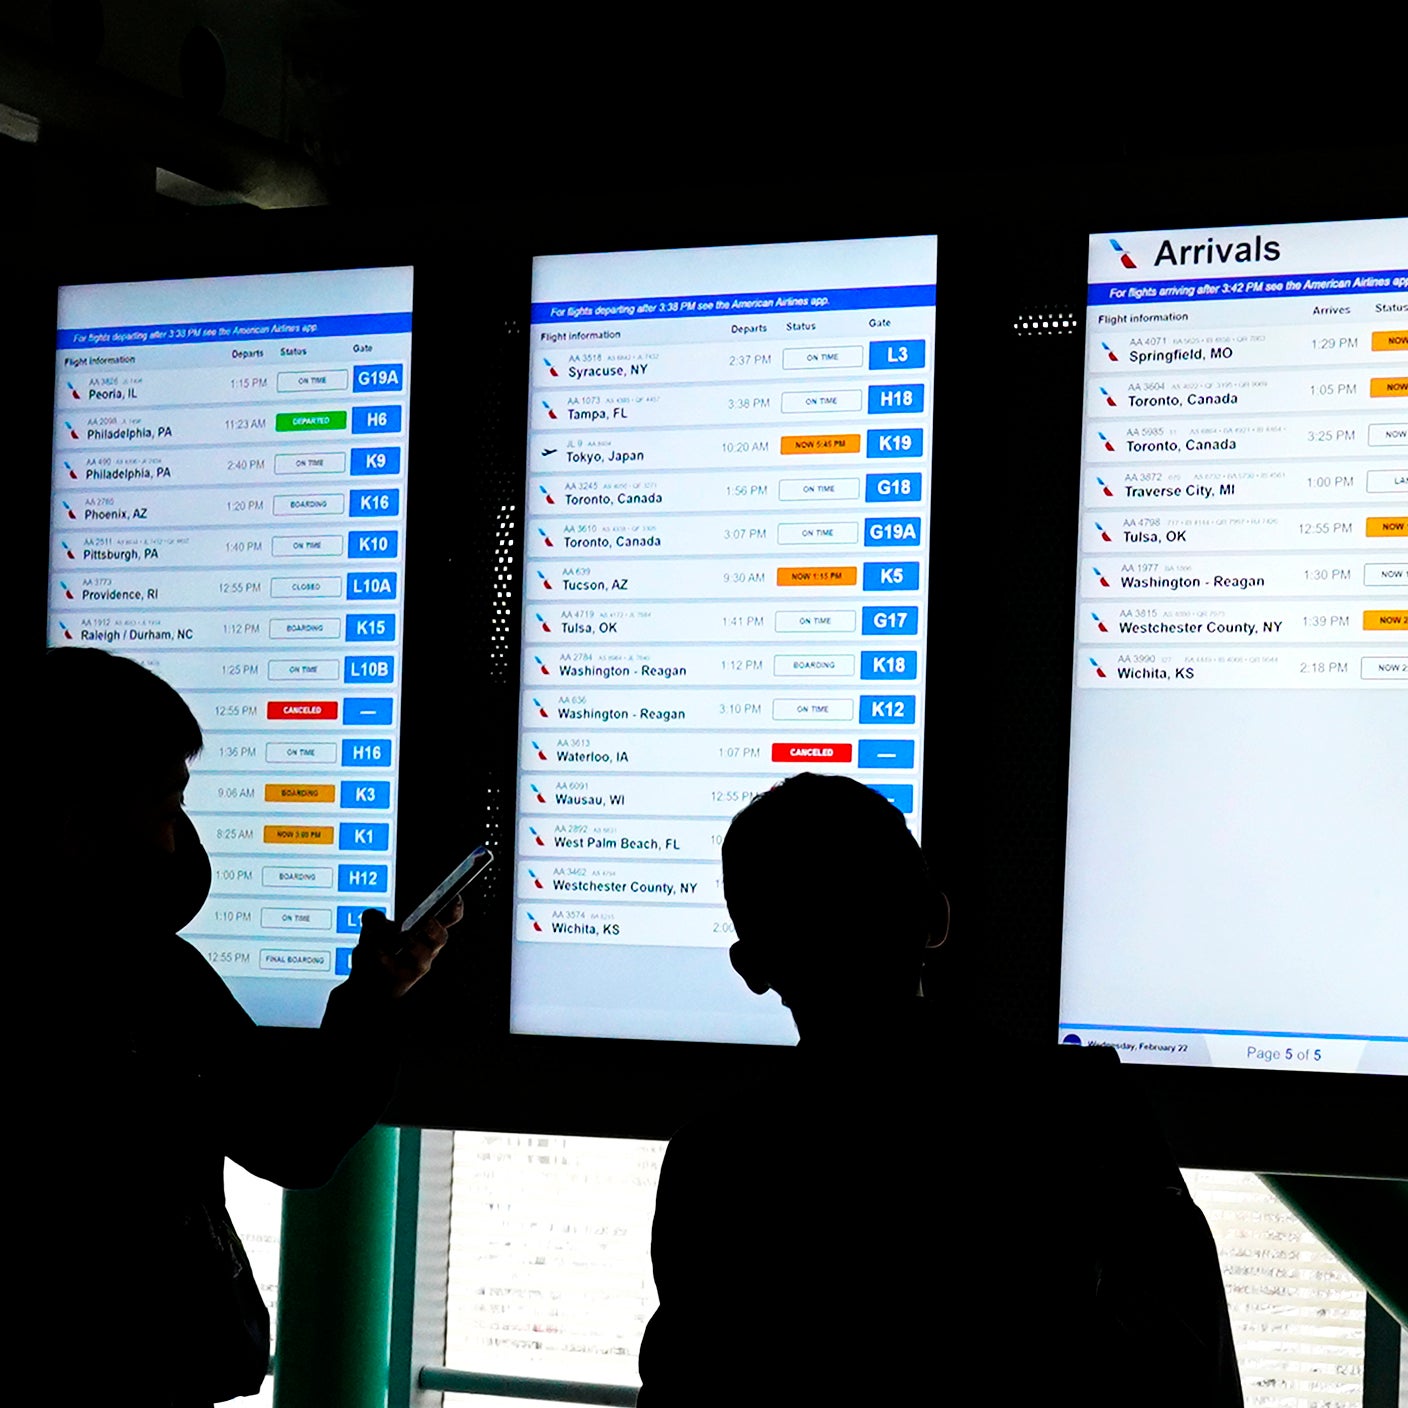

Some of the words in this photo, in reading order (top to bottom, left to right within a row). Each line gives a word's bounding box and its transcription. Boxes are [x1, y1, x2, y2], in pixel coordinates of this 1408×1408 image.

[1154, 235, 1280, 266] Arrivals
[1109, 288, 1127, 298] For
[1127, 288, 1157, 299] flights
[1159, 286, 1195, 297] arriving
[1197, 284, 1220, 294] after
[1222, 282, 1244, 293] 3:42
[1244, 282, 1265, 292] PM
[1264, 283, 1283, 291] see
[1286, 281, 1303, 290] the
[1303, 279, 1351, 290] American
[1351, 277, 1390, 288] Airlines
[1313, 306, 1350, 315] Arrives
[1376, 303, 1408, 312] Status
[1098, 314, 1127, 326] Flight
[1130, 313, 1188, 322] information
[1312, 338, 1333, 349] 1:29
[1337, 338, 1358, 348] PM
[888, 347, 908, 362] L3
[1130, 349, 1205, 364] Springfield,
[1211, 347, 1233, 358] MO
[358, 370, 398, 385] G19A
[569, 366, 626, 380] Syracuse,
[631, 364, 647, 375] NY
[89, 389, 125, 400] Peoria,
[128, 388, 137, 398] IL
[881, 391, 912, 406] H18
[1129, 396, 1182, 407] Toronto,
[1187, 393, 1237, 405] Canada
[368, 413, 387, 426] H6
[568, 409, 609, 421] Tampa,
[613, 408, 627, 418] FL
[88, 428, 154, 440] Philadelphia,
[158, 427, 172, 437] PA
[880, 435, 912, 451] K19
[1127, 441, 1180, 452] Toronto,
[1186, 439, 1236, 450] Canada
[367, 454, 386, 468] K9
[567, 452, 604, 464] Tokyo,
[608, 451, 644, 463] Japan
[878, 479, 910, 494] G18
[1308, 477, 1329, 487] 1:00
[1332, 476, 1353, 486] PM
[1125, 486, 1181, 497] Traverse
[1186, 485, 1214, 499] City,
[1220, 484, 1234, 495] MI
[361, 495, 389, 509] K16
[565, 494, 613, 505] Toronto,
[618, 493, 662, 504] Canada
[85, 509, 130, 520] Phoenix,
[133, 508, 147, 519] AZ
[870, 524, 916, 539] G19A
[1300, 523, 1328, 534] 12:55
[1331, 523, 1352, 533] PM
[360, 537, 388, 551] K10
[1124, 531, 1161, 543] Tulsa,
[1166, 531, 1186, 542] OK
[84, 549, 140, 562] Pittsburgh,
[145, 548, 158, 559] PA
[881, 568, 903, 583] K5
[354, 579, 391, 593] L10A
[563, 580, 608, 591] Tucson,
[612, 579, 628, 590] AZ
[1121, 577, 1200, 590] Washington
[1214, 576, 1264, 589] Reagan
[357, 621, 385, 634] K15
[874, 613, 907, 628] G17
[562, 623, 595, 634] Tulsa,
[599, 622, 617, 633] OK
[1120, 622, 1202, 633] Westchester
[1207, 622, 1258, 636] County,
[1263, 621, 1282, 632] NY
[81, 630, 120, 643] Raleigh
[130, 629, 174, 640] Durham,
[177, 629, 193, 639] NC
[351, 662, 388, 676] L10B
[560, 665, 629, 679] Washington
[640, 665, 686, 679] Reagan
[874, 657, 905, 673] K18
[1300, 662, 1323, 673] 2:18
[1326, 662, 1348, 672] PM
[1118, 668, 1170, 680] Wichita,
[1176, 668, 1194, 679] KS
[558, 708, 628, 722] Washington
[639, 708, 685, 722] Reagan
[872, 701, 904, 717] K12
[354, 746, 381, 759] H16
[557, 751, 612, 763] Waterloo,
[617, 752, 628, 762] IA
[788, 746, 835, 759] CANCELED
[356, 788, 375, 801] K3
[556, 794, 605, 806] Wausau,
[610, 795, 624, 805] WI
[355, 829, 372, 843] K1
[555, 837, 583, 848] West
[588, 837, 616, 848] Palm
[621, 838, 661, 850] Beach,
[666, 838, 680, 850] FL
[350, 871, 377, 885] H12
[553, 880, 626, 892] Westchester
[631, 881, 676, 896] County,
[681, 882, 697, 893] NY
[552, 923, 599, 935] Wichita,
[603, 924, 619, 935] KS
[1139, 1042, 1175, 1053] February
[1247, 1046, 1280, 1062] Page
[1285, 1048, 1293, 1060] 5
[1297, 1049, 1309, 1061] of
[1314, 1049, 1321, 1061] 5
